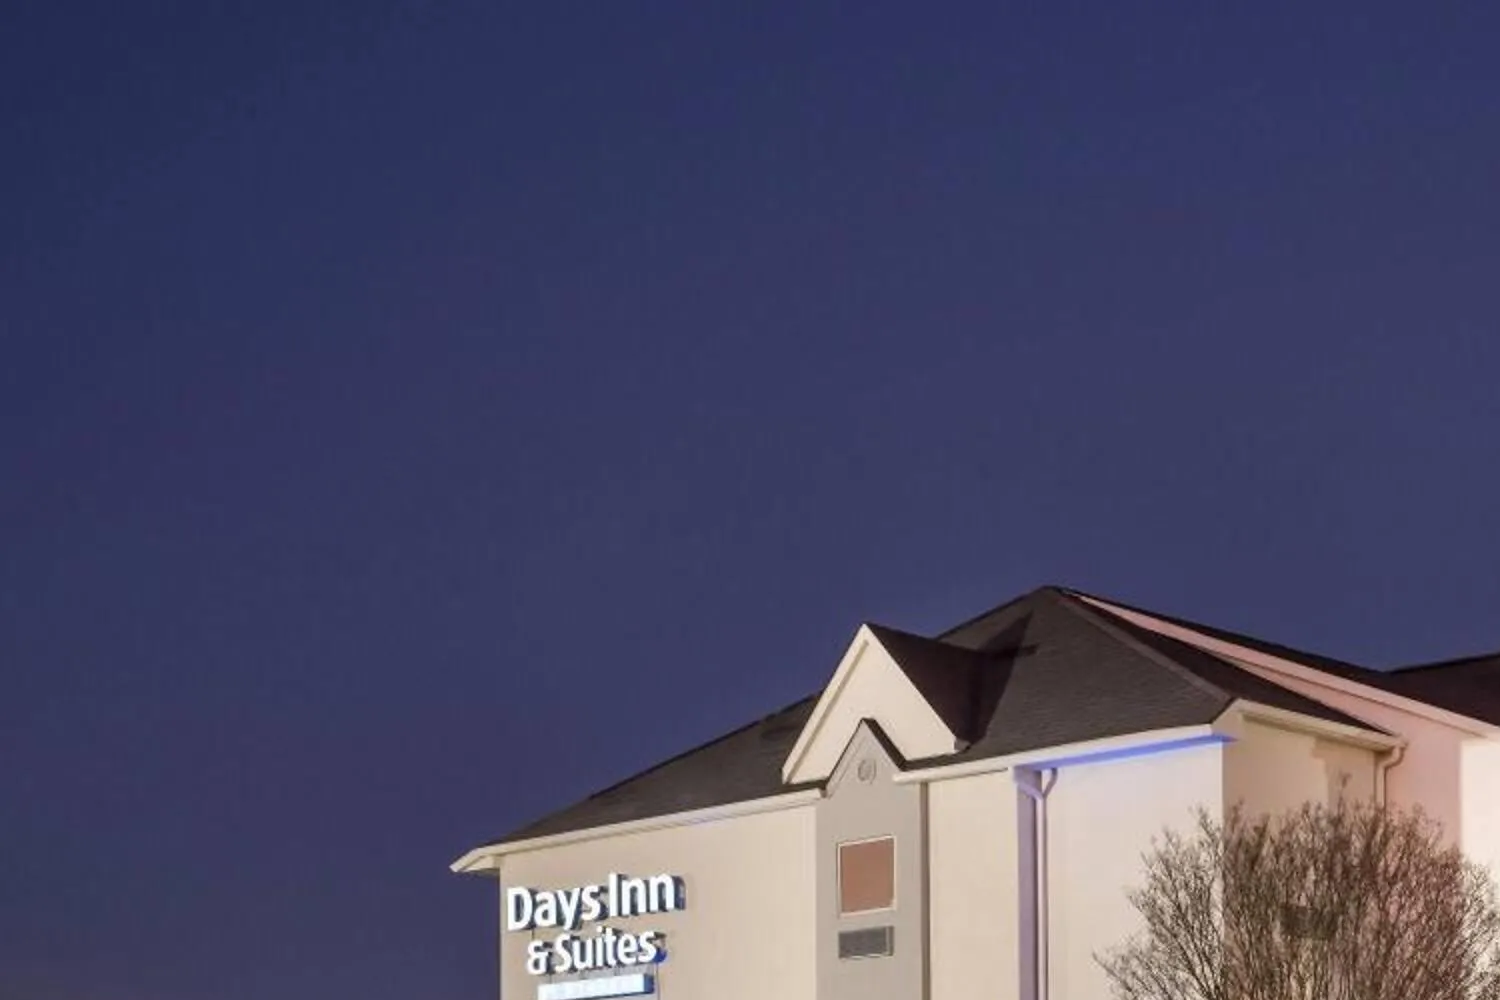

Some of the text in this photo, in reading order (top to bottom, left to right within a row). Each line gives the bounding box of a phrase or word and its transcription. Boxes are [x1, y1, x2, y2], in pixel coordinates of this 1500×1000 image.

[507, 872, 675, 931] Days Inn
[526, 925, 657, 975] & Suites
